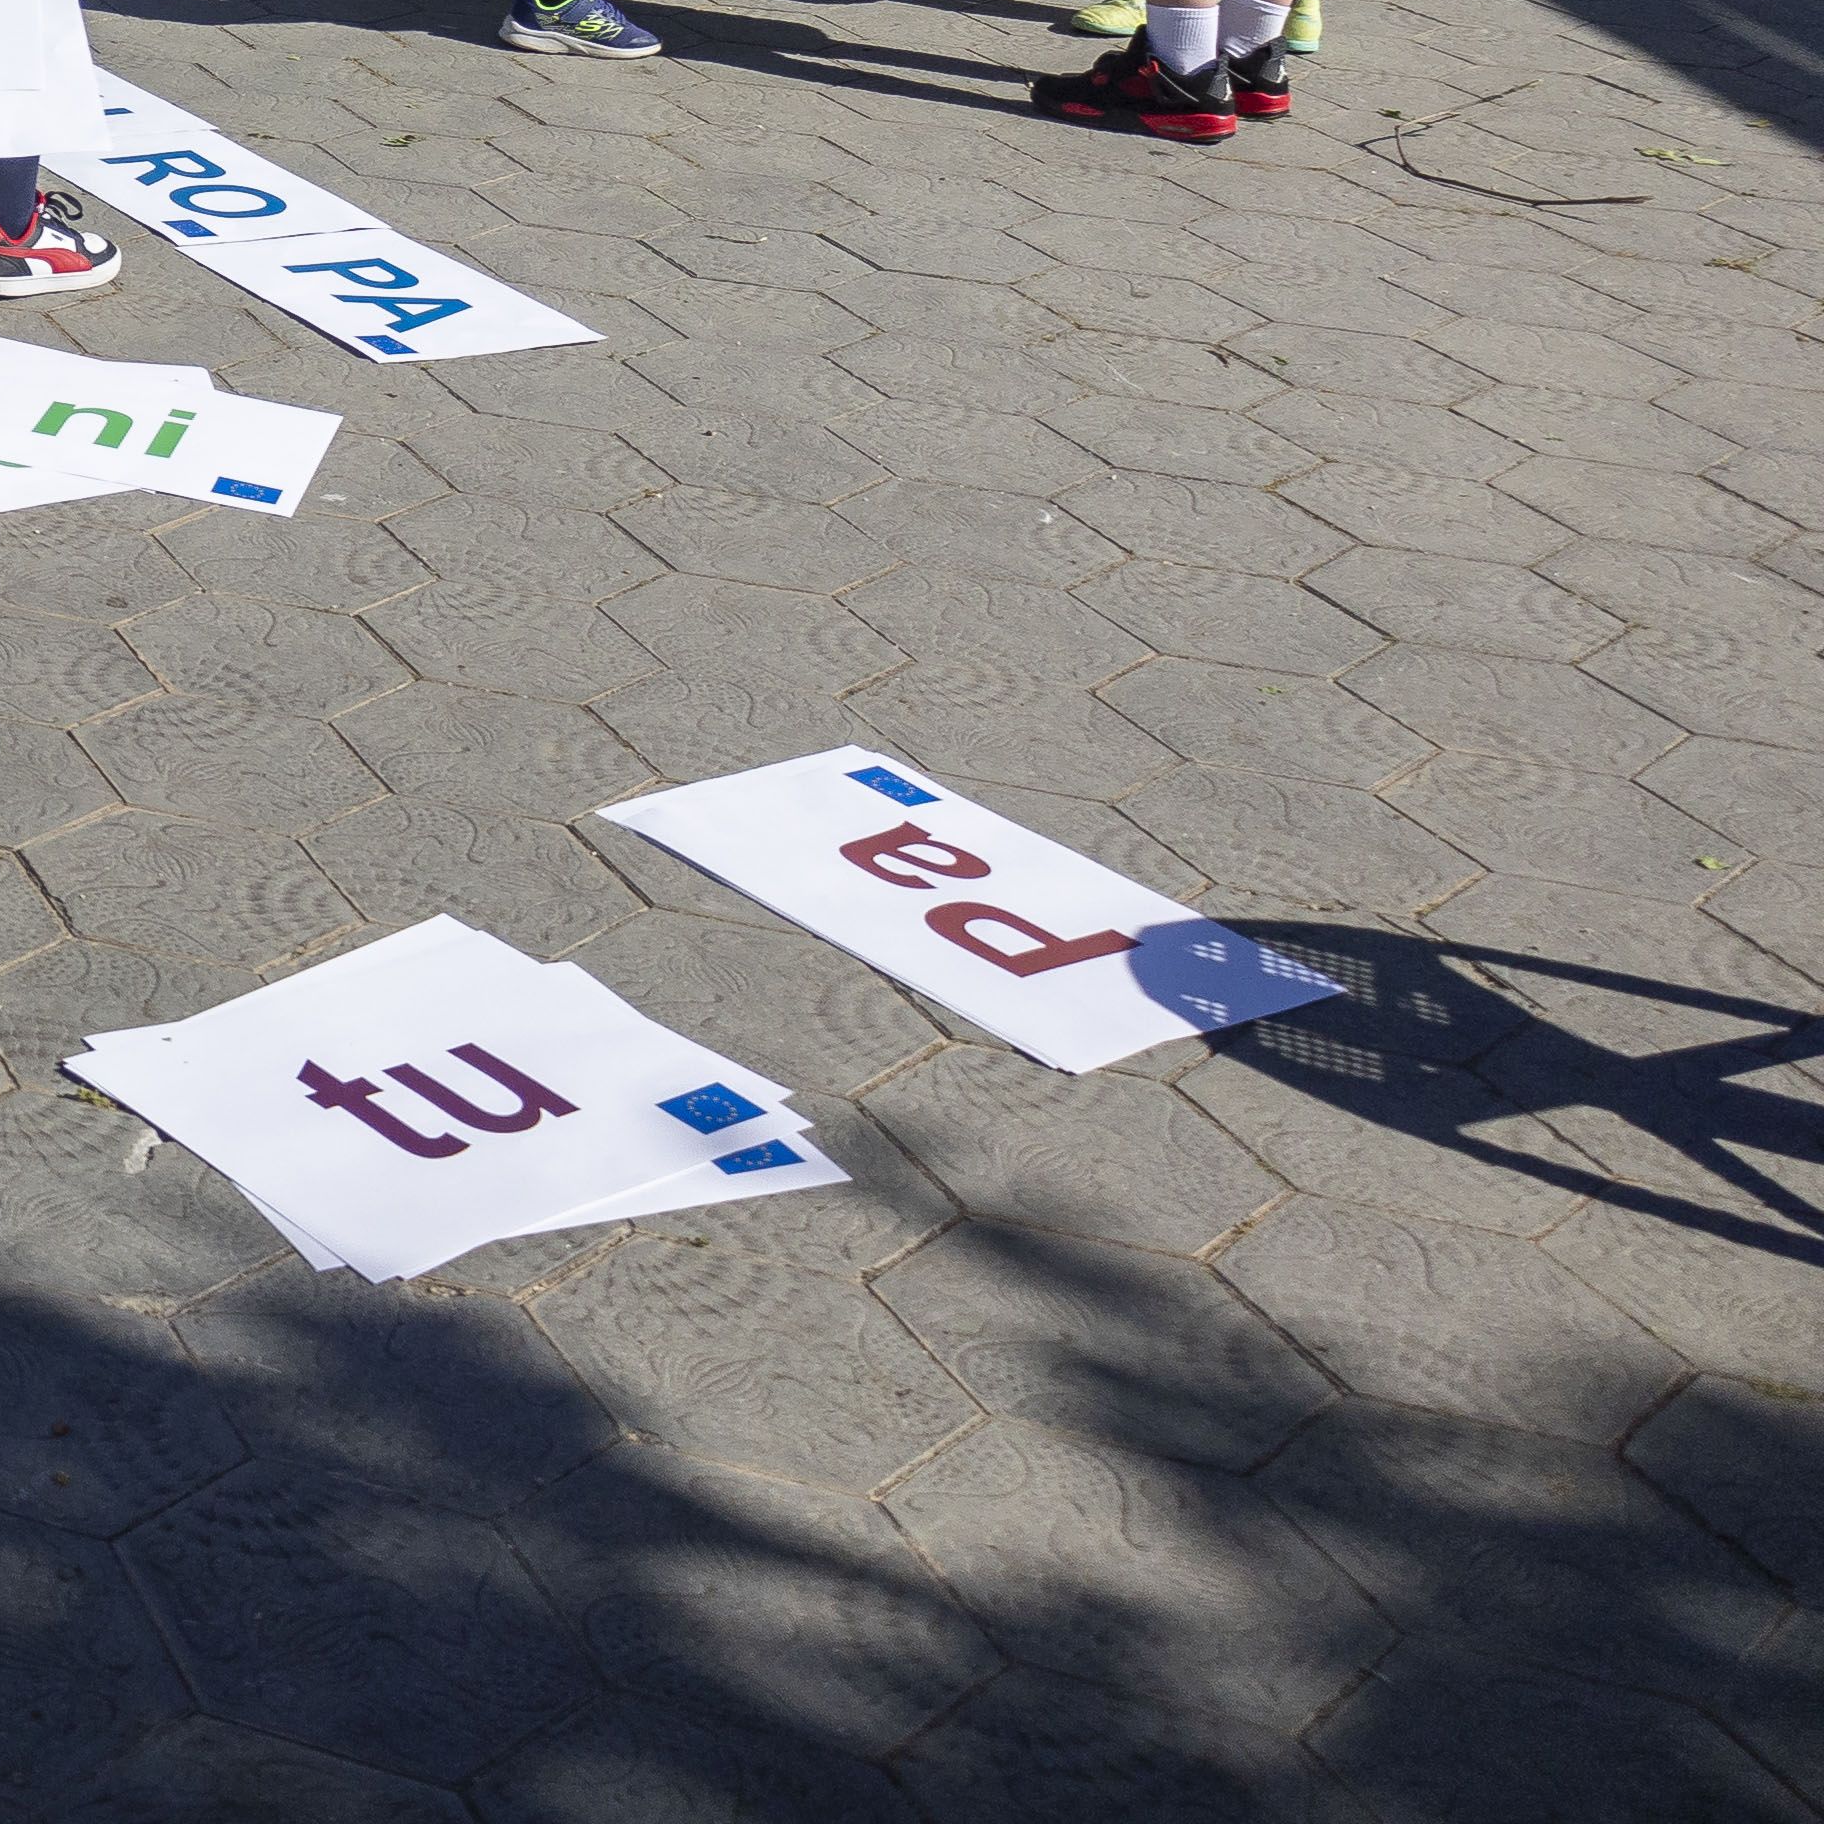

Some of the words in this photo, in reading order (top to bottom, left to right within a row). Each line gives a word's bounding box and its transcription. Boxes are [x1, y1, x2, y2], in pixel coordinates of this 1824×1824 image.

[98, 149, 288, 219] RO
[283, 257, 473, 333] PA
[31, 401, 198, 459] ni
[838, 818, 1142, 978] Pa
[296, 1040, 581, 1159] tu
